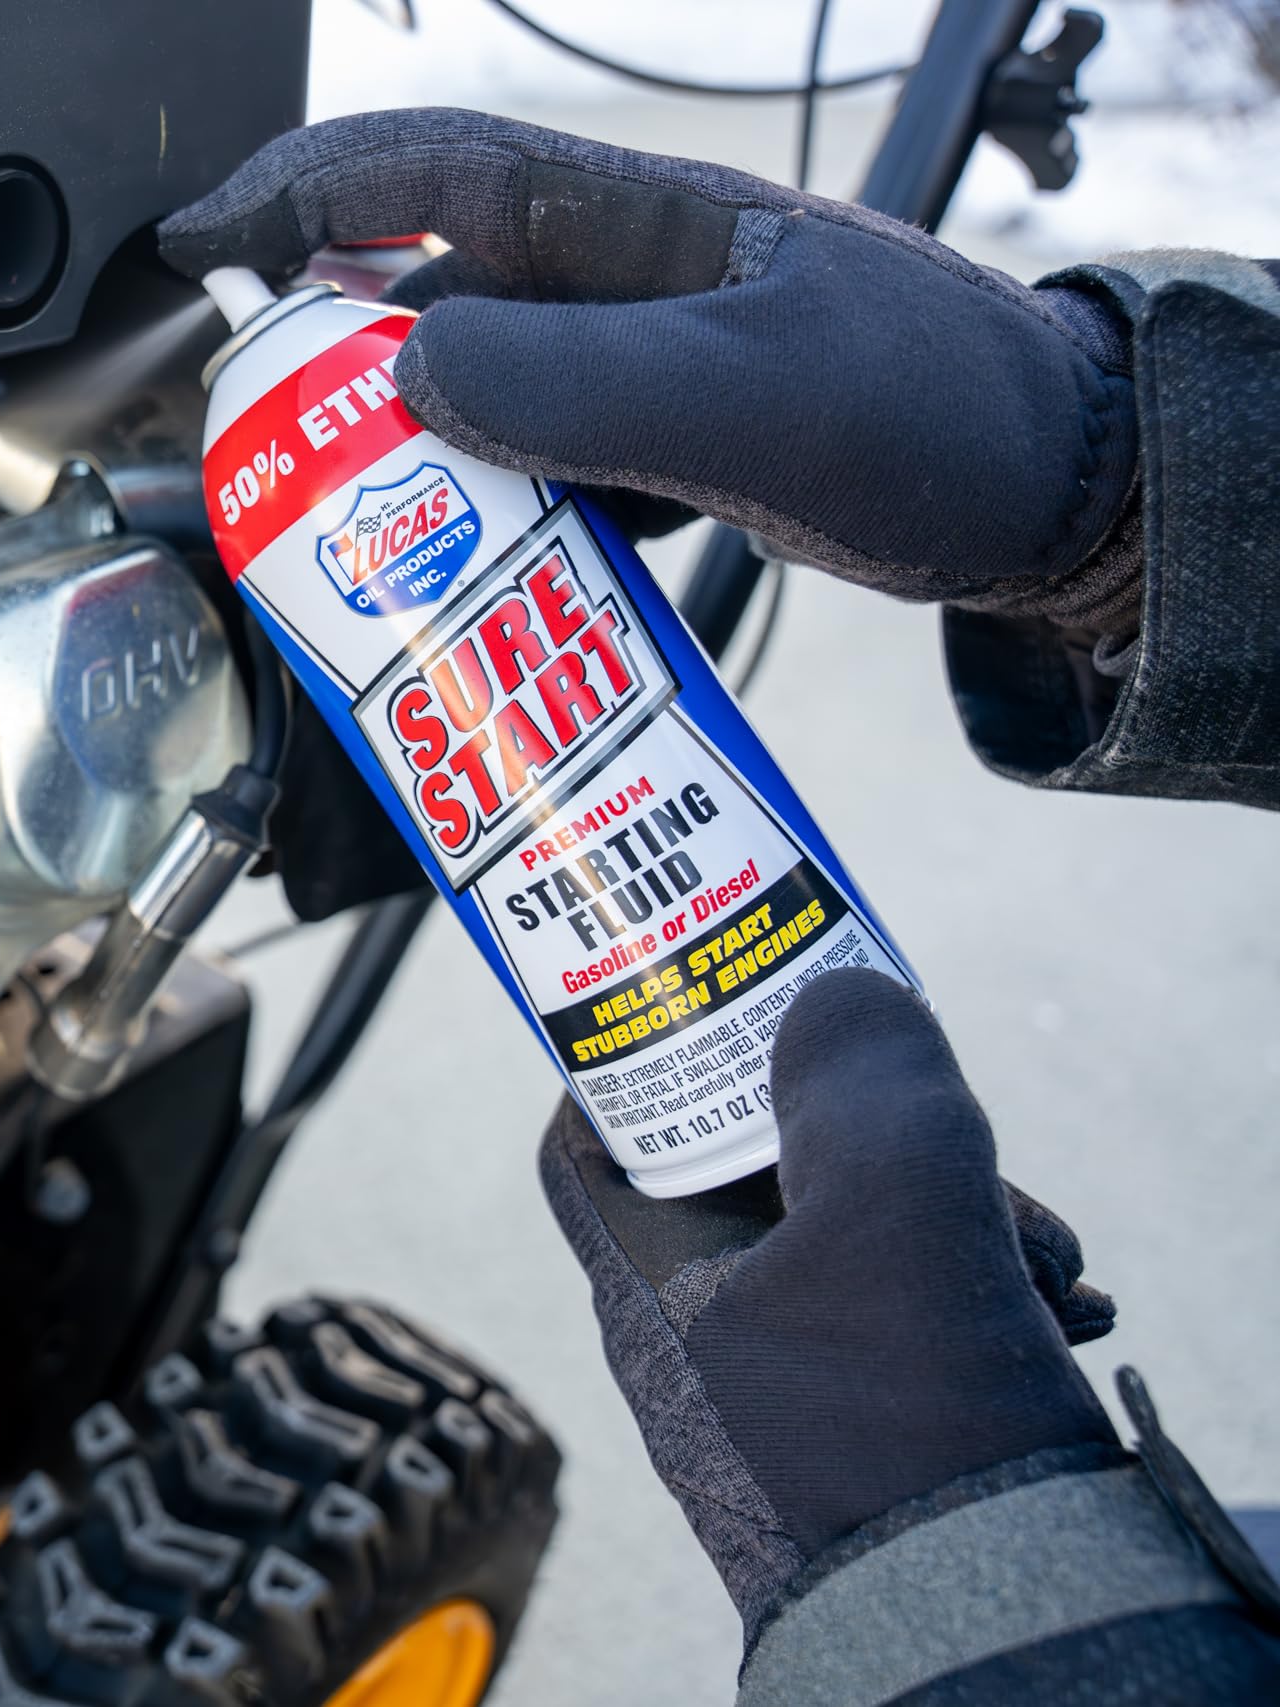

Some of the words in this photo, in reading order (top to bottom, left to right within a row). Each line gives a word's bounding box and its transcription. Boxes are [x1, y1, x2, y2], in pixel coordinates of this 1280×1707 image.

[218, 438, 295, 526] 50%
[297, 355, 398, 451] ETH
[352, 487, 449, 586] LUCAS
[385, 476, 446, 519] PERFORMANCE
[356, 585, 385, 608] OIL
[384, 520, 476, 588] PRODUCTS
[408, 568, 447, 597] INC.
[395, 554, 591, 772] SURE
[420, 609, 634, 850] START
[505, 781, 720, 931] STARTING
[518, 775, 656, 872] PREMIUM
[561, 934, 657, 995] Gasoline
[662, 912, 688, 943] or
[690, 858, 762, 924] Diesel
[566, 849, 703, 952] FLUID
[572, 981, 712, 1063] STUBBORN
[716, 899, 827, 993] ENGINES
[581, 1073, 626, 1096] DANGER:
[622, 1053, 678, 1087] EXTREMELY
[675, 1018, 746, 1064] FLAMMABLE.
[742, 982, 797, 1026] CONTENTS
[821, 929, 861, 969] PRESSURE
[593, 964, 684, 1027] HELPS
[687, 903, 773, 977] START
[593, 1094, 631, 1113] HARMFUL
[627, 1089, 645, 1105] OR
[641, 1078, 675, 1101] FATAL
[671, 1071, 685, 1089] IF
[683, 1035, 759, 1083] SWALLOWED.
[604, 1114, 624, 1129] SKIN
[620, 1103, 664, 1127] IRRITANT.
[660, 1092, 689, 1115] Read
[690, 1071, 737, 1103] carefully
[737, 1054, 766, 1079] other
[633, 1133, 661, 1155] NET
[658, 1125, 690, 1149] WT.
[688, 1107, 726, 1139] 10.7
[725, 1094, 755, 1121] OZ
